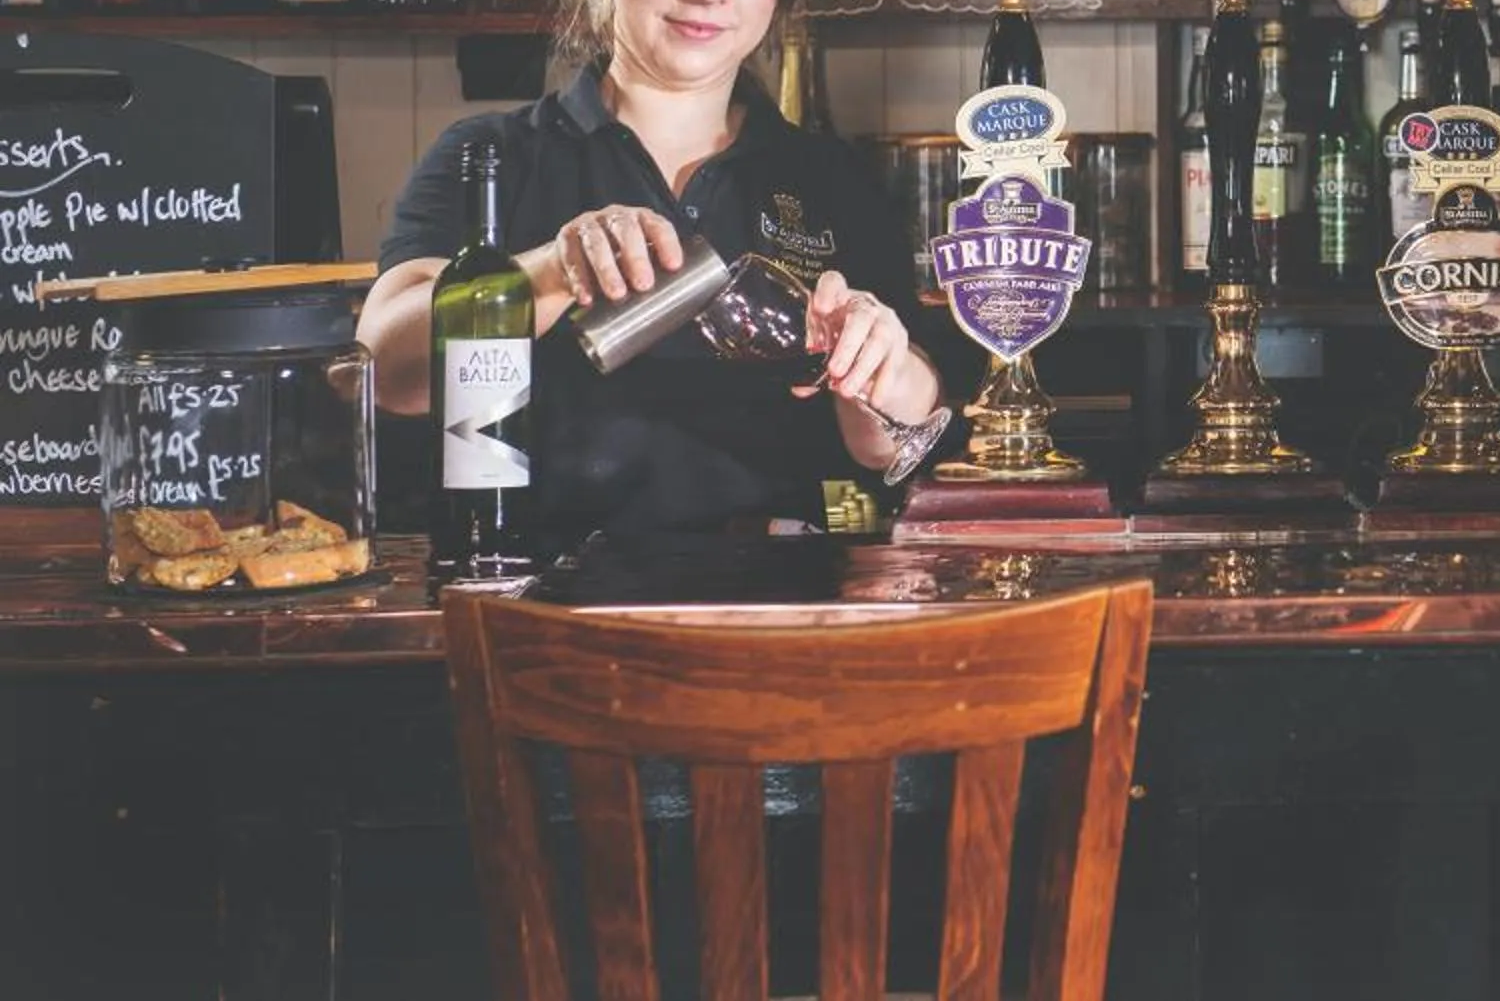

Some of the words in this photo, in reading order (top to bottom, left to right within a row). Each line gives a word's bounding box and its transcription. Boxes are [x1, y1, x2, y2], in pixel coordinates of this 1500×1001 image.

[987, 100, 1031, 118] CASK
[976, 113, 1048, 134] MARQUE
[1441, 121, 1481, 136] CASK
[1437, 135, 1497, 150] ARQUE
[1432, 163, 1464, 175] Cellar
[1467, 162, 1491, 174] Cool
[66, 191, 108, 232] Pie
[937, 235, 1084, 274] TRIBUTE
[469, 350, 512, 366] ALTA
[9, 359, 101, 394] cheese
[459, 366, 521, 383] BALIZA
